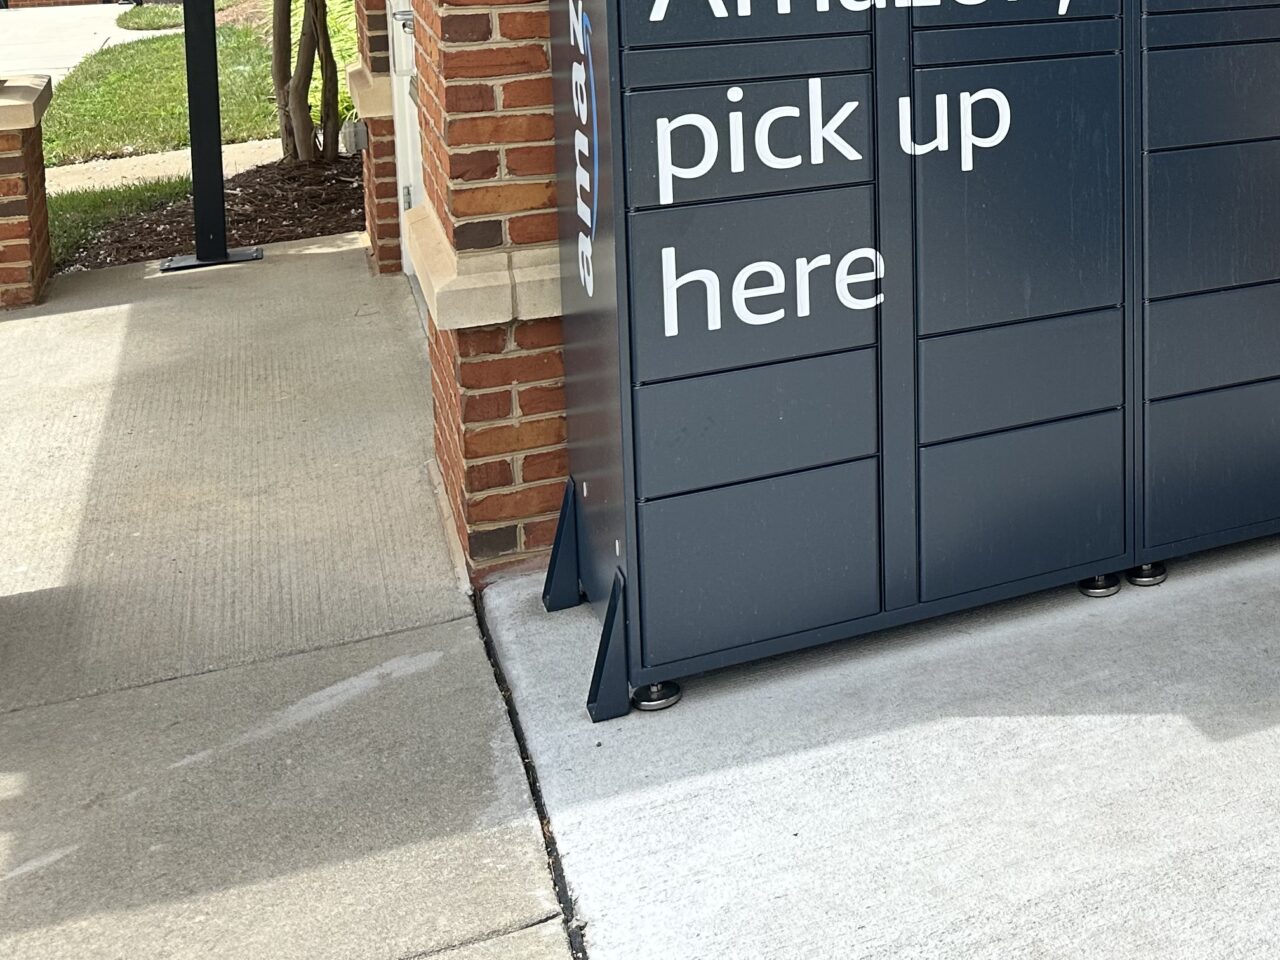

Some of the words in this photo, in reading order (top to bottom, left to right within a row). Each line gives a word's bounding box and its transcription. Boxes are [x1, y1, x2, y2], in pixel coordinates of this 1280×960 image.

[654, 77, 863, 205] pick
[898, 88, 1011, 172] up
[661, 246, 885, 338] here
